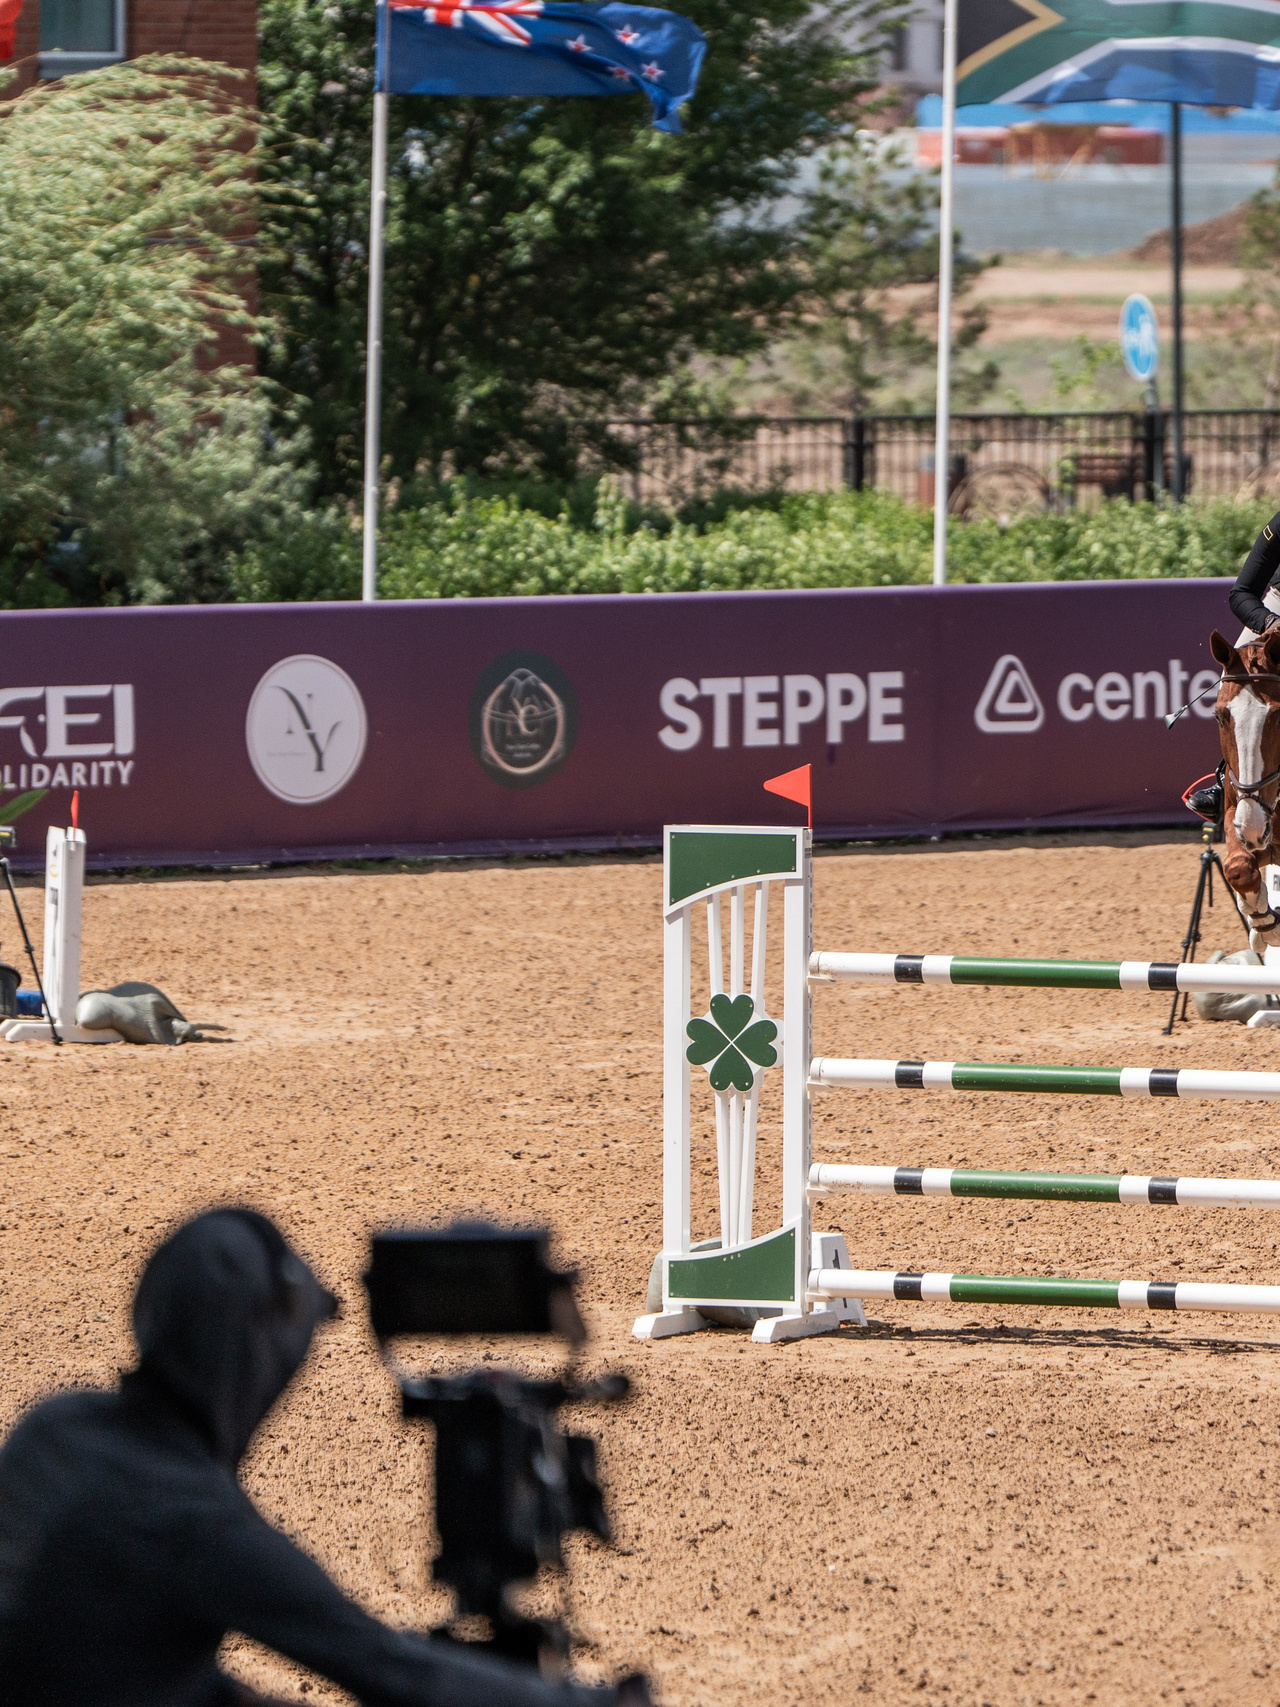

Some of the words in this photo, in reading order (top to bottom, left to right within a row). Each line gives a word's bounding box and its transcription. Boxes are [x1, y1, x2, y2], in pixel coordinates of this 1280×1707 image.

[657, 671, 905, 751] STEPPE
[1057, 659, 1222, 722] cente
[0, 760, 135, 789] LIDARITY
